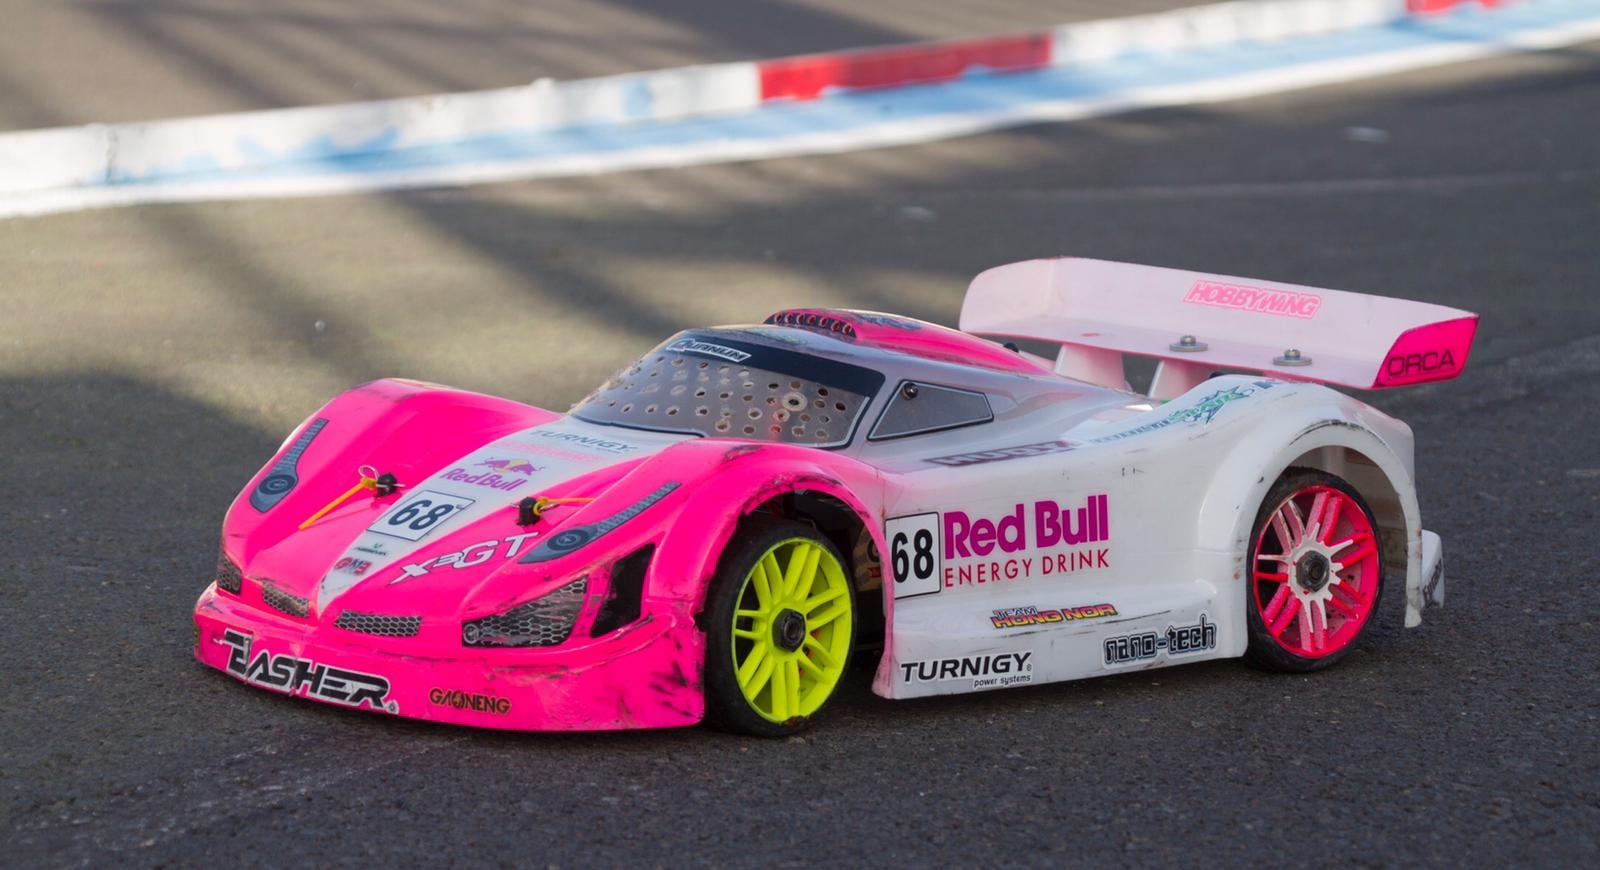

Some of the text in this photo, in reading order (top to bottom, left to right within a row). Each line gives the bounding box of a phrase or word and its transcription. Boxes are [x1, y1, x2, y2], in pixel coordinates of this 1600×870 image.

[1185, 280, 1321, 319] HOBBYWING
[1387, 350, 1455, 376] ORCA
[530, 430, 637, 452] TURNIGY
[388, 500, 453, 530] 68
[944, 504, 1026, 559] Red
[1035, 495, 1109, 548] Bull
[891, 529, 934, 583] 68
[945, 549, 1109, 587] ENERGY DRINK
[993, 606, 1037, 618] TEAM
[1062, 603, 1118, 620] NOR
[1104, 613, 1217, 664] nano-tech
[974, 675, 1031, 687] power systems
